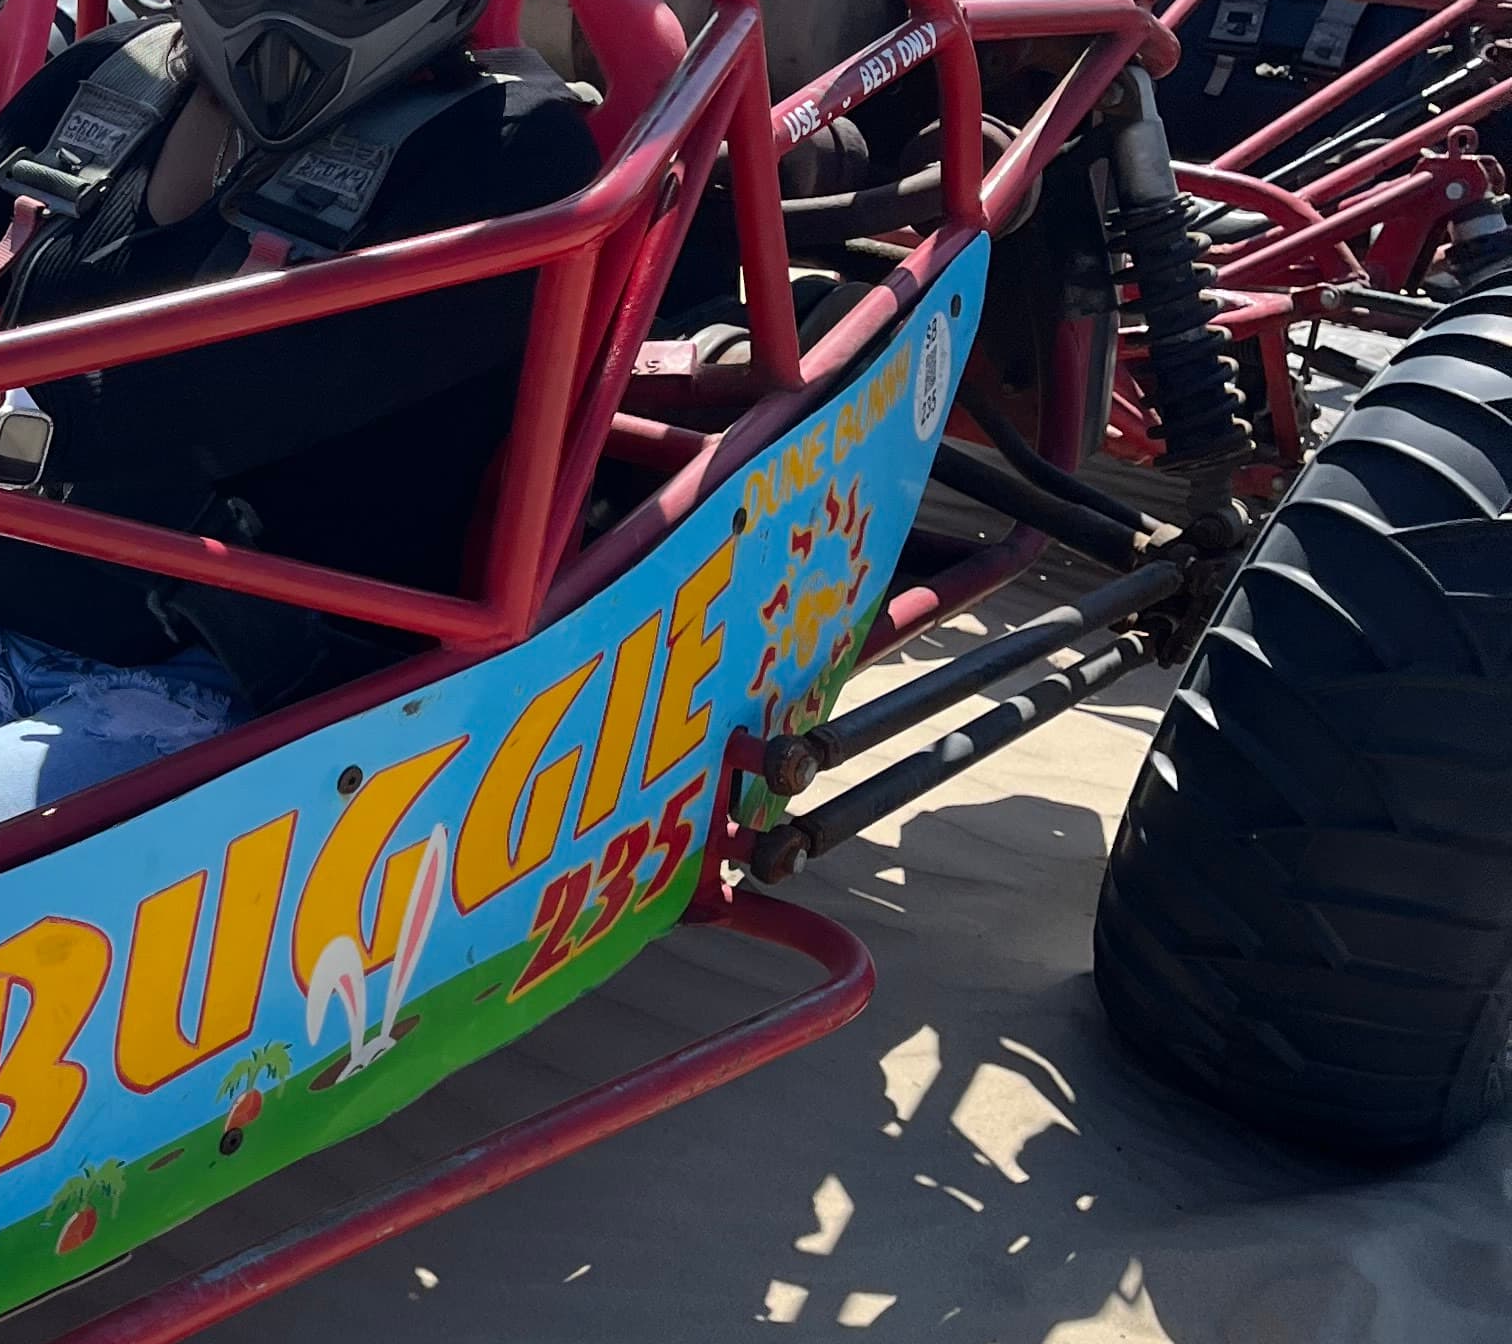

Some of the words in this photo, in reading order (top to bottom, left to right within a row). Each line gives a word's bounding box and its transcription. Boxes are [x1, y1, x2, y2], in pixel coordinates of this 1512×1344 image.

[783, 99, 822, 144] USE
[859, 47, 898, 96] BELT
[896, 22, 937, 68] ONLY
[743, 418, 831, 536] DUNE
[506, 768, 710, 1004] 235
